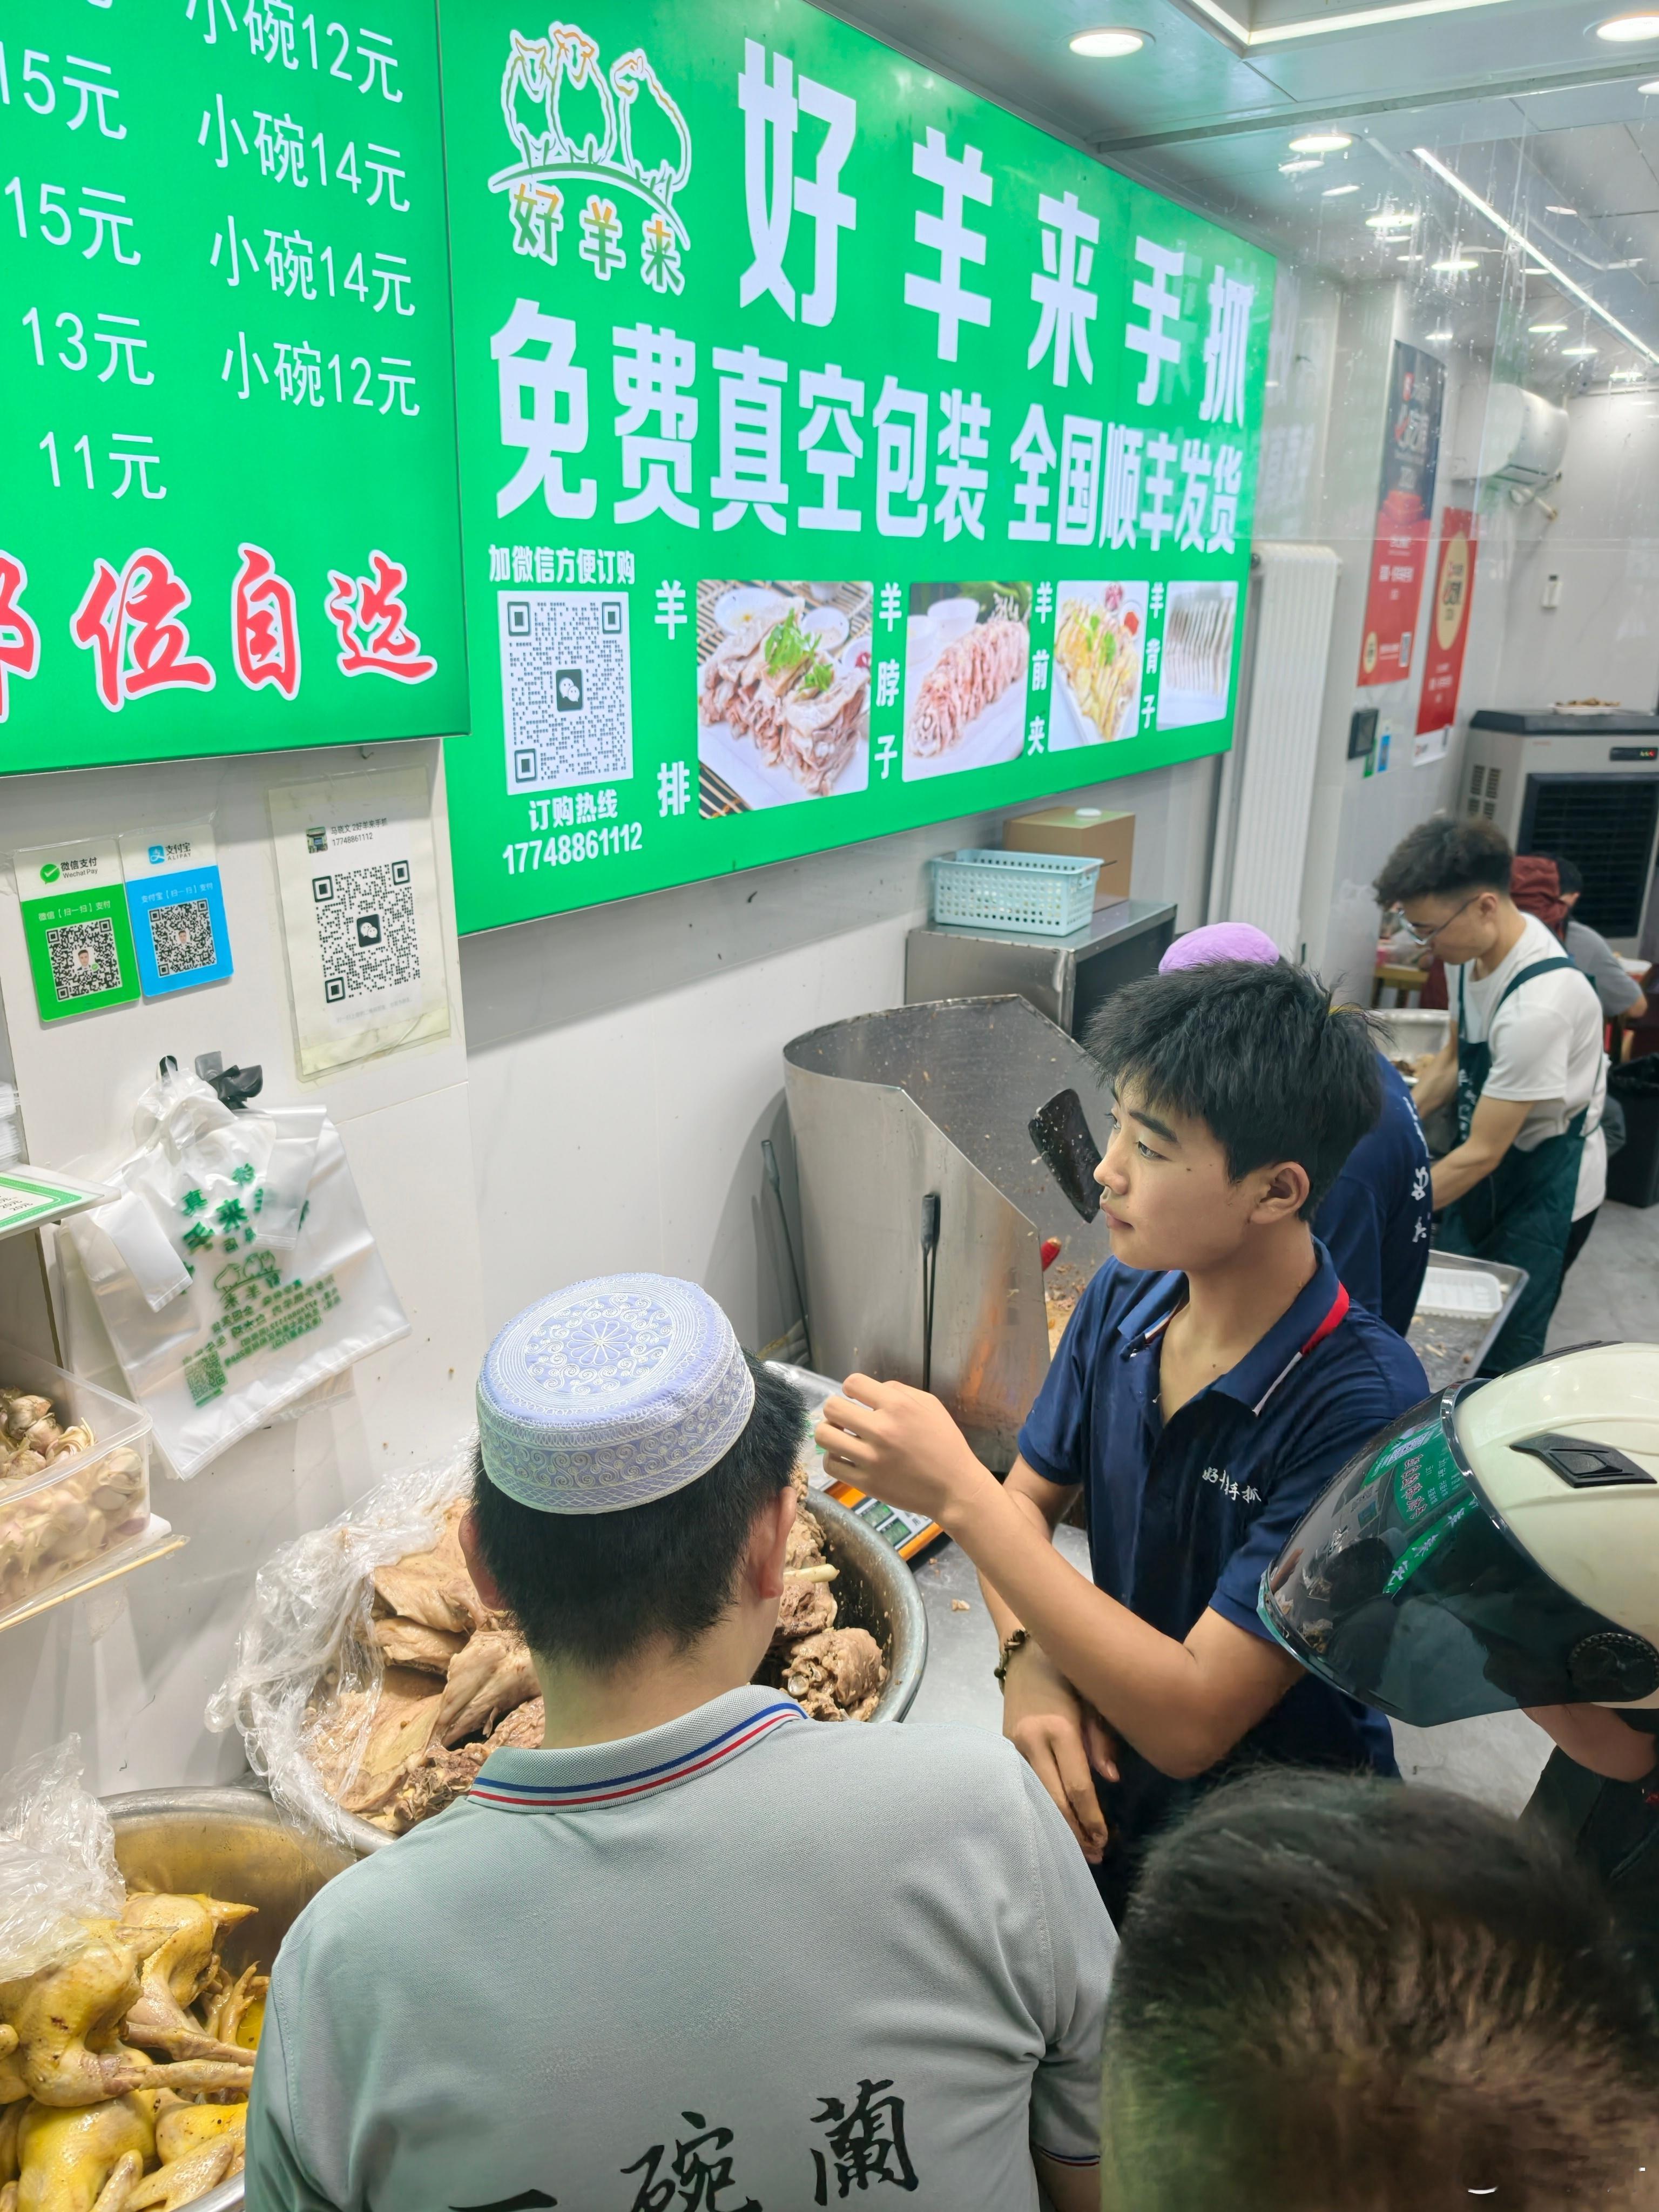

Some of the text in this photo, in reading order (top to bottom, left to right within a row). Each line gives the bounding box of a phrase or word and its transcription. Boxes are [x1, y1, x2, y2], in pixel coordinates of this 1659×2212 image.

[186, 0, 403, 103] 小碗12元
[198, 93, 410, 212] 小碗14元
[5, 177, 415, 316] 15元 小碗14元
[509, 181, 685, 295] 好羊来
[738, 38, 1255, 429] 好羊来手抓
[22, 307, 420, 416] 13元 小碗12元
[39, 431, 167, 500] 11元
[490, 298, 1243, 554] 免费真空包装 全国顺丰发货
[488, 544, 635, 584] 加微信方便订购
[655, 580, 691, 817] 羊排
[874, 582, 902, 780] 羊脖子
[1027, 582, 1053, 756] 羊前夹
[60, 857, 97, 872] 微信支付
[165, 842, 191, 855] 支付宝
[332, 832, 373, 847] 17748861112
[503, 822, 643, 875] 17748861112
[529, 789, 618, 832] 订购热线
